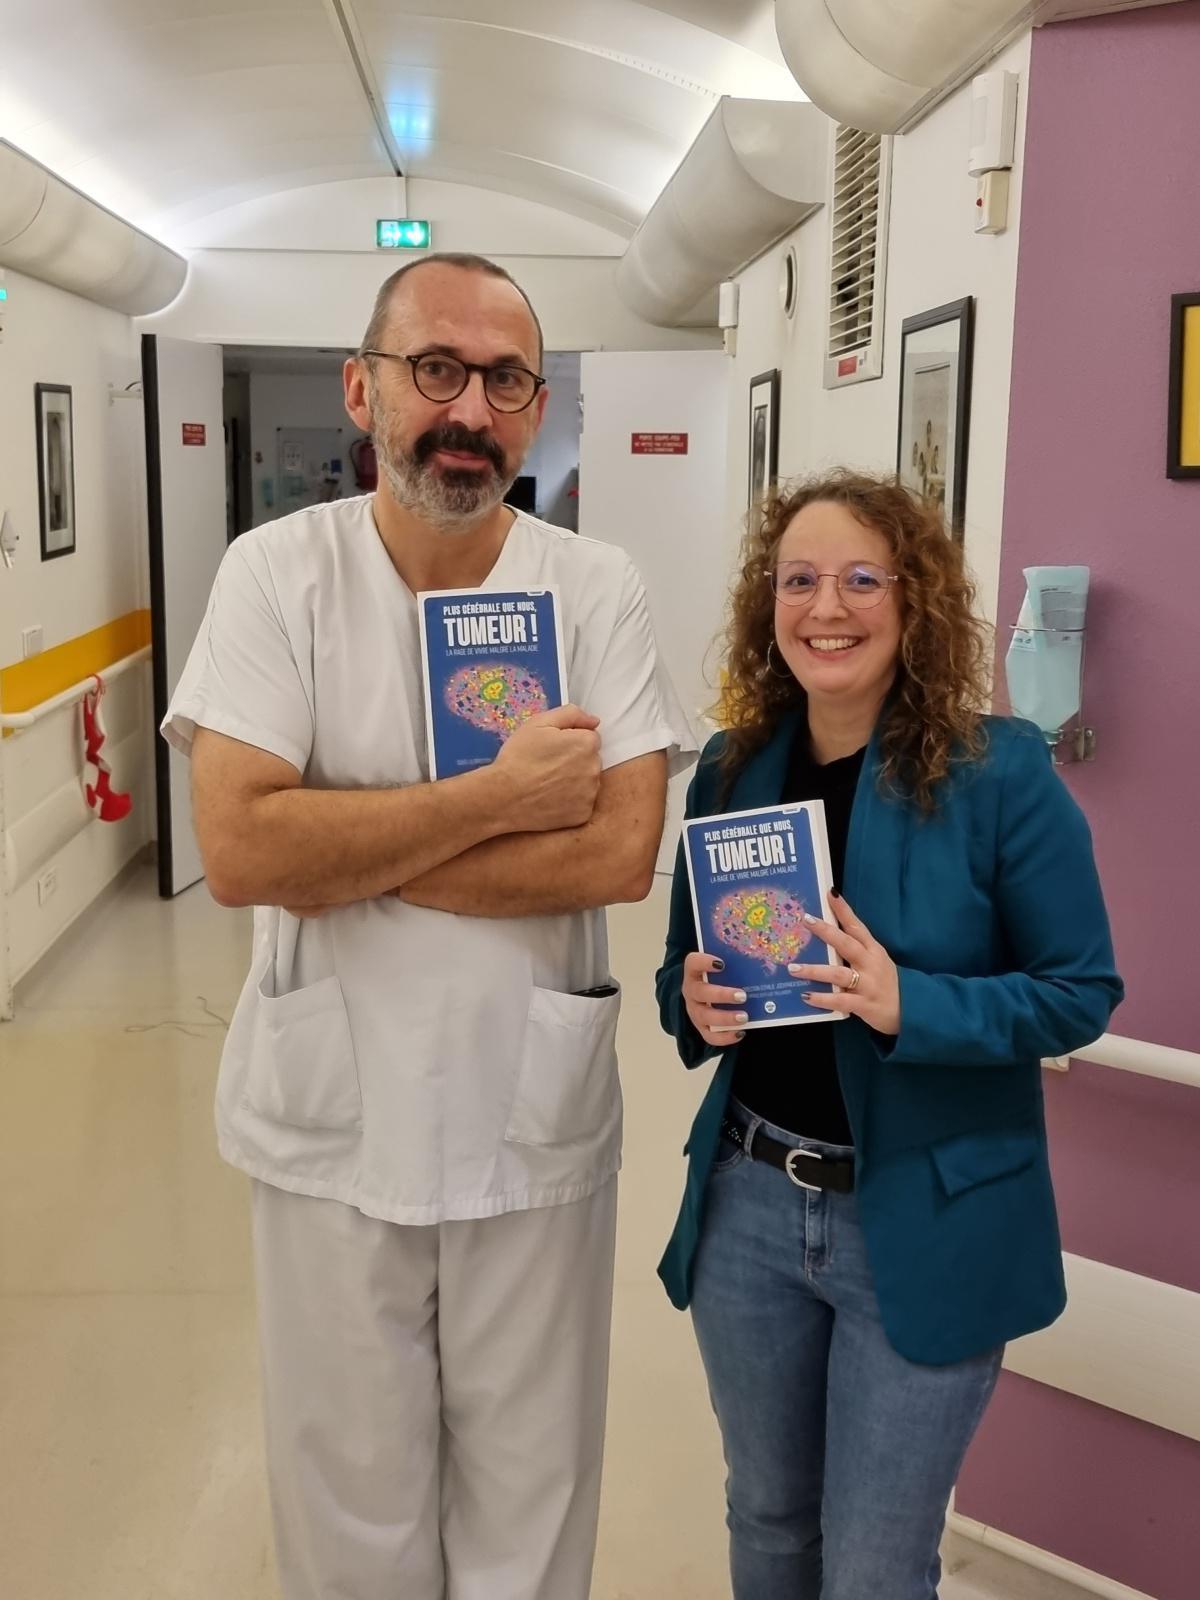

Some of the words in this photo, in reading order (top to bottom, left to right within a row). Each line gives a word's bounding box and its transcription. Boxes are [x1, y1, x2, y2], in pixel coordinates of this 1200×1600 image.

[443, 605, 461, 616] PLUS
[462, 602, 501, 614] CÉRÉBRALE
[502, 602, 515, 613] QUE
[517, 601, 537, 612] NOUS,
[443, 614, 527, 647] TUMEUR
[530, 613, 538, 642] !
[704, 832, 721, 842] PLUS
[722, 825, 758, 839] CÉRÉBRALE
[759, 823, 772, 833] QUE
[774, 820, 793, 831] NOUS,
[706, 834, 786, 873] TUMEUR
[788, 832, 797, 862] !
